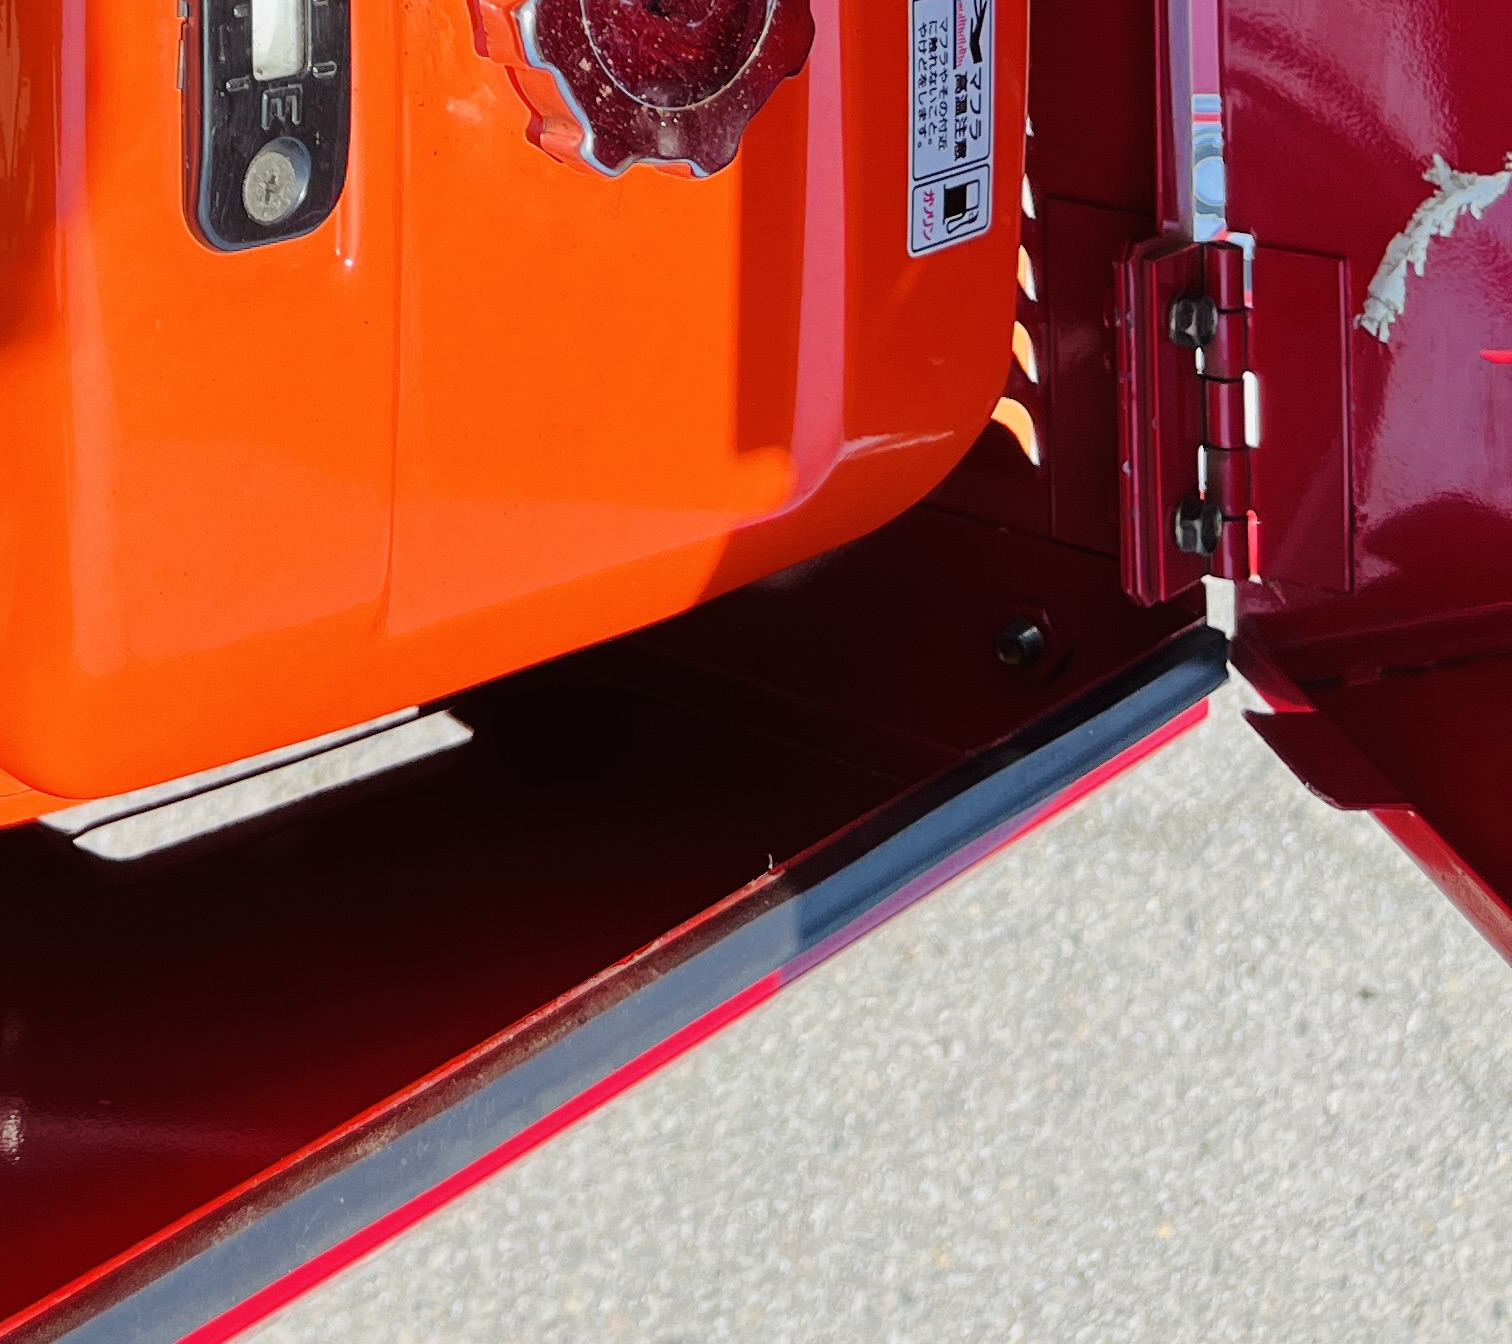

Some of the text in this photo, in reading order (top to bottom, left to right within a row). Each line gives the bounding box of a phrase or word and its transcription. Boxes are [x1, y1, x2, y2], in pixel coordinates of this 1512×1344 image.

[260, 82, 304, 132] E
[918, 23, 927, 149] やけどをします。
[928, 21, 937, 146] に触れないこと。
[939, 17, 948, 151] マフラやその付近
[954, 72, 968, 161] 高温注意
[970, 68, 982, 141] マフラ
[923, 191, 935, 241] ガソリン
